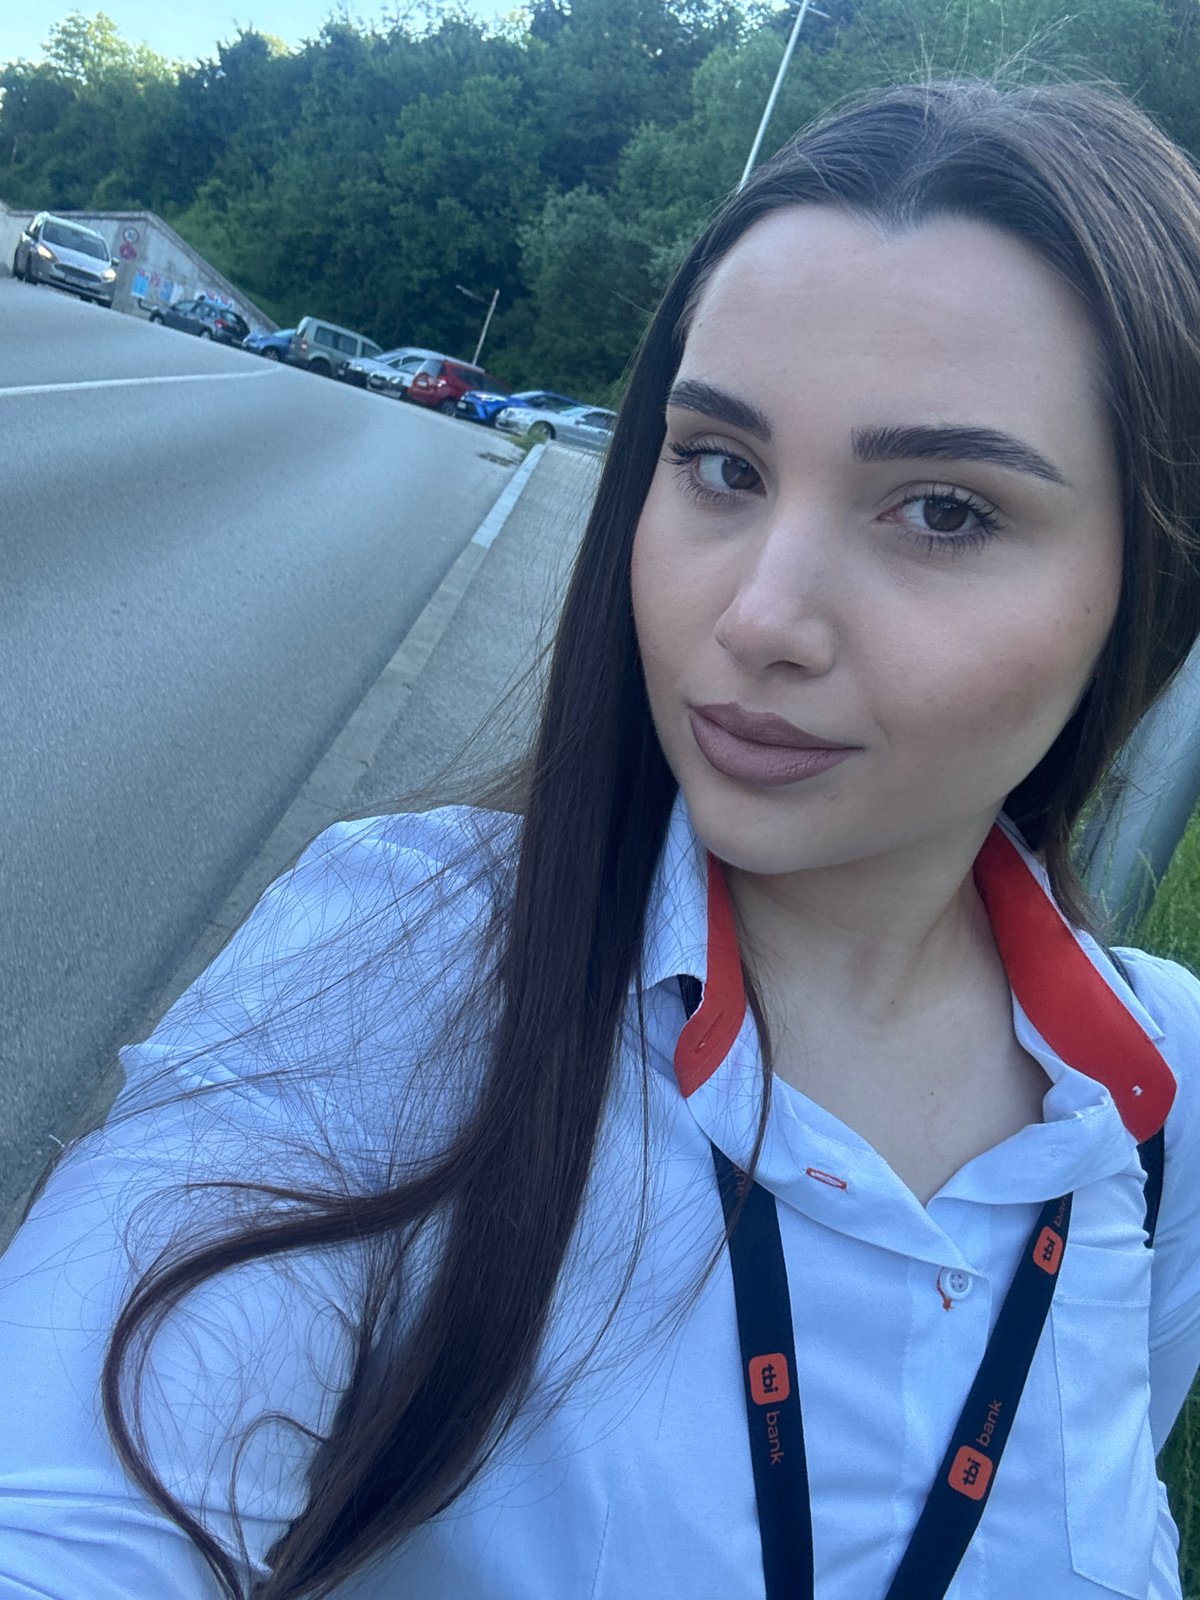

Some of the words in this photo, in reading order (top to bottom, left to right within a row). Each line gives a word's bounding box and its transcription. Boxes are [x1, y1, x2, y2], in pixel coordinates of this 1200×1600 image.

[1042, 1236, 1056, 1262] tbi
[761, 1363, 779, 1394] tbi
[766, 1410, 785, 1466] bank
[962, 1457, 982, 1486] tbi
[976, 1399, 1002, 1447] bank
